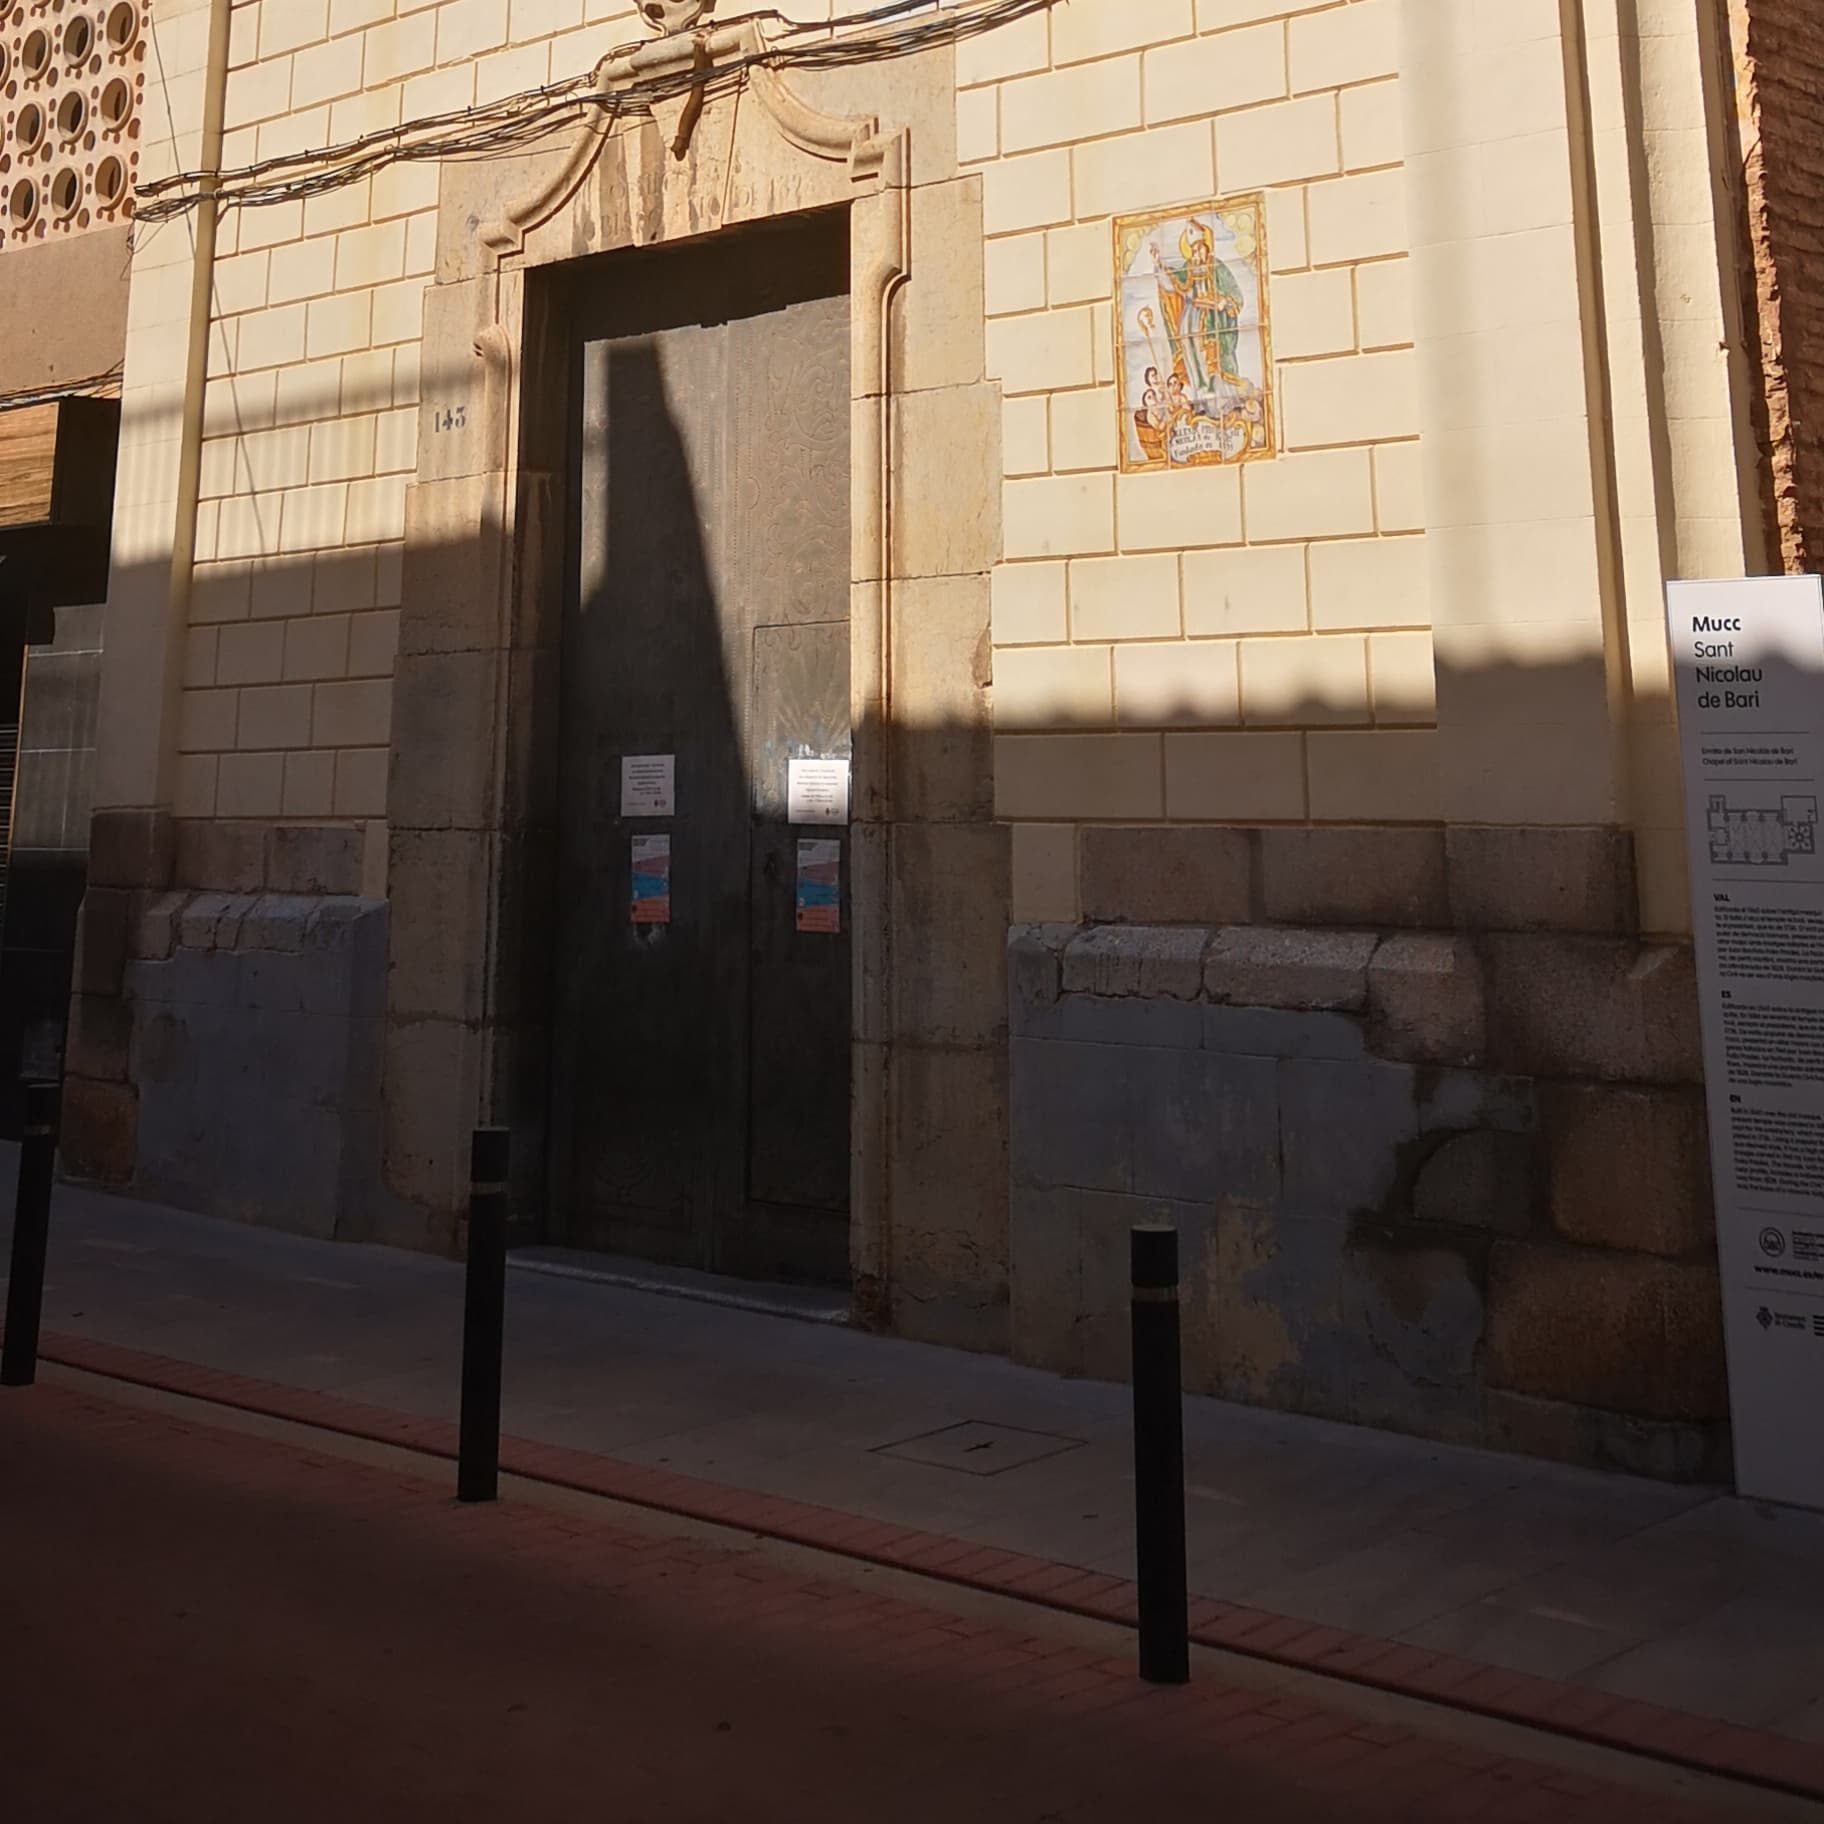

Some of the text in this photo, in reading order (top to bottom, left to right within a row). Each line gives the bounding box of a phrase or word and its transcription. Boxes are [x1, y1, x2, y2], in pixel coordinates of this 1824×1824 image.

[1692, 616, 1742, 632] Mucc
[1694, 640, 1734, 658] Sant
[1696, 666, 1763, 683] Nicolau
[1697, 691, 1760, 708] de Bari
